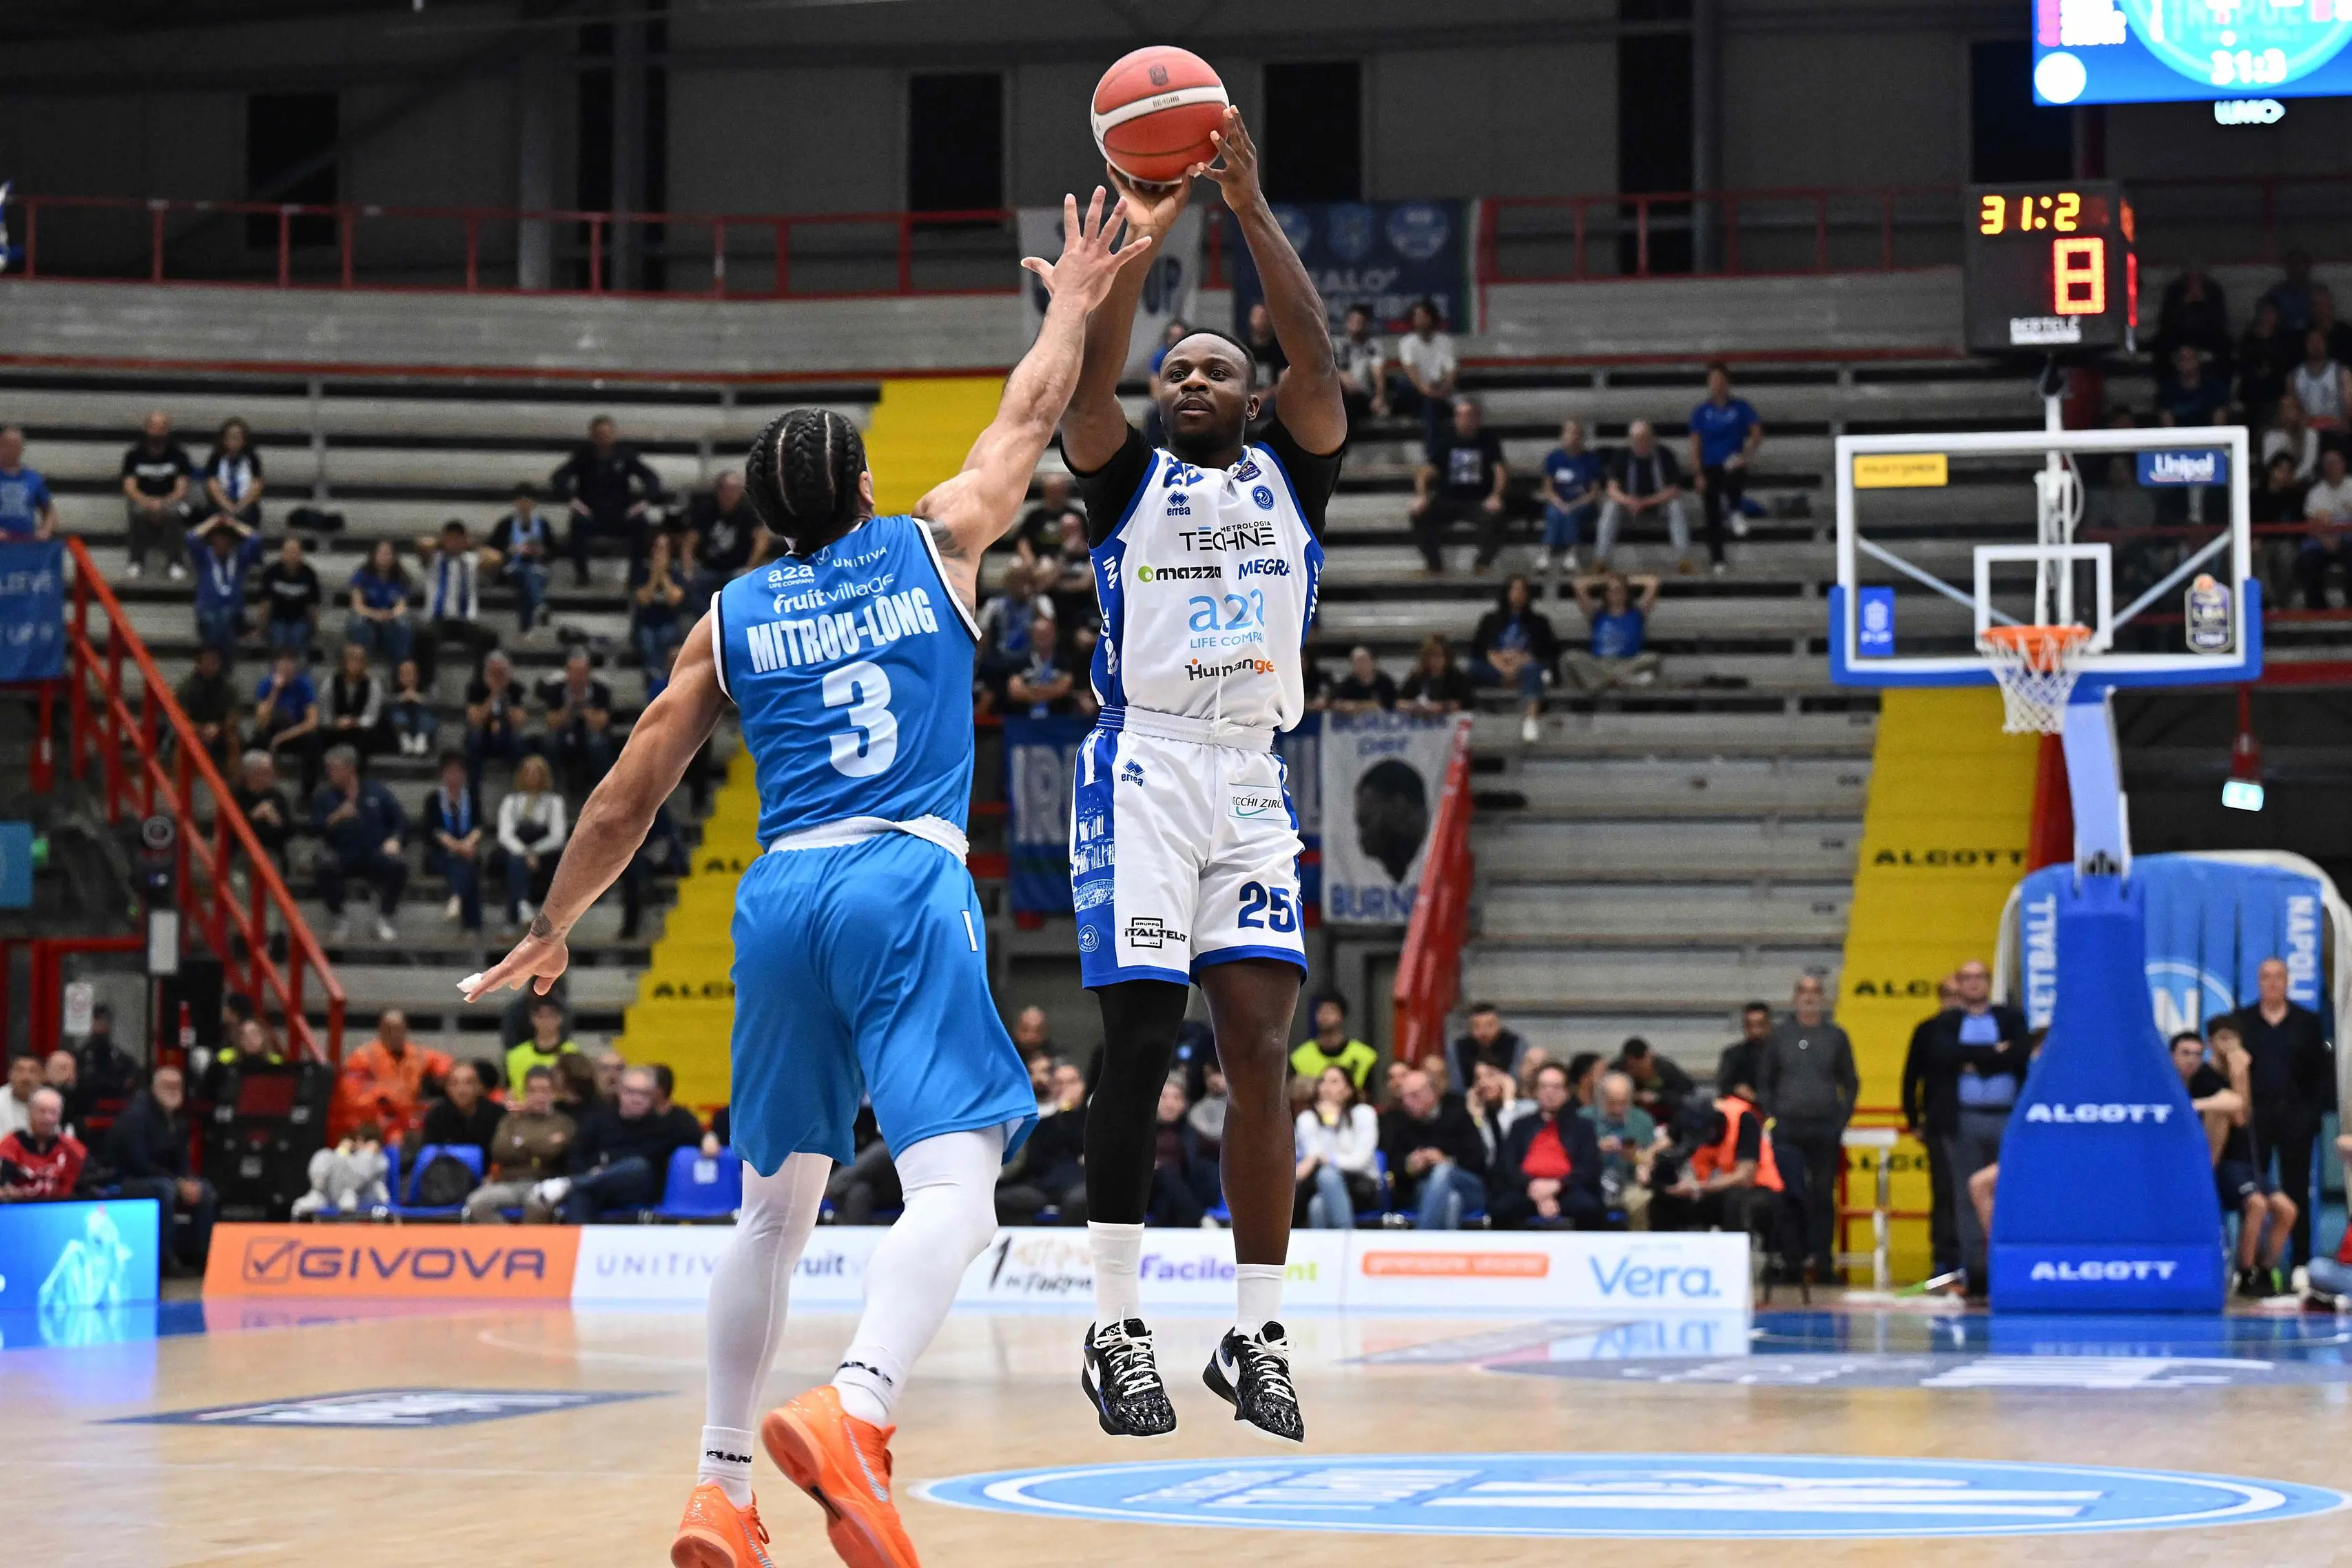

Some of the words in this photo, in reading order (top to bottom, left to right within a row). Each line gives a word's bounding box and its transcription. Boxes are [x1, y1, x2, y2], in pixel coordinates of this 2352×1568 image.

[1981, 193, 2080, 234] 31:2
[2054, 237, 2104, 314] 8
[2154, 452, 2215, 482] Unipol
[1166, 506, 1191, 517] errea
[1220, 520, 1271, 533] METROLOGIA
[833, 546, 888, 569] UNITIVA
[767, 564, 815, 583] a2a
[746, 587, 939, 673] MITROU-LONG
[1190, 637, 1217, 649] LIFE
[822, 661, 898, 778] 3
[1121, 773, 1144, 787] errea
[1239, 880, 1297, 933] 25
[2025, 1104, 2174, 1124] ALCOTT
[297, 1246, 547, 1280] GIVOVA
[595, 1252, 721, 1277] UNITIV
[2030, 1260, 2178, 1281] ALCOTT
